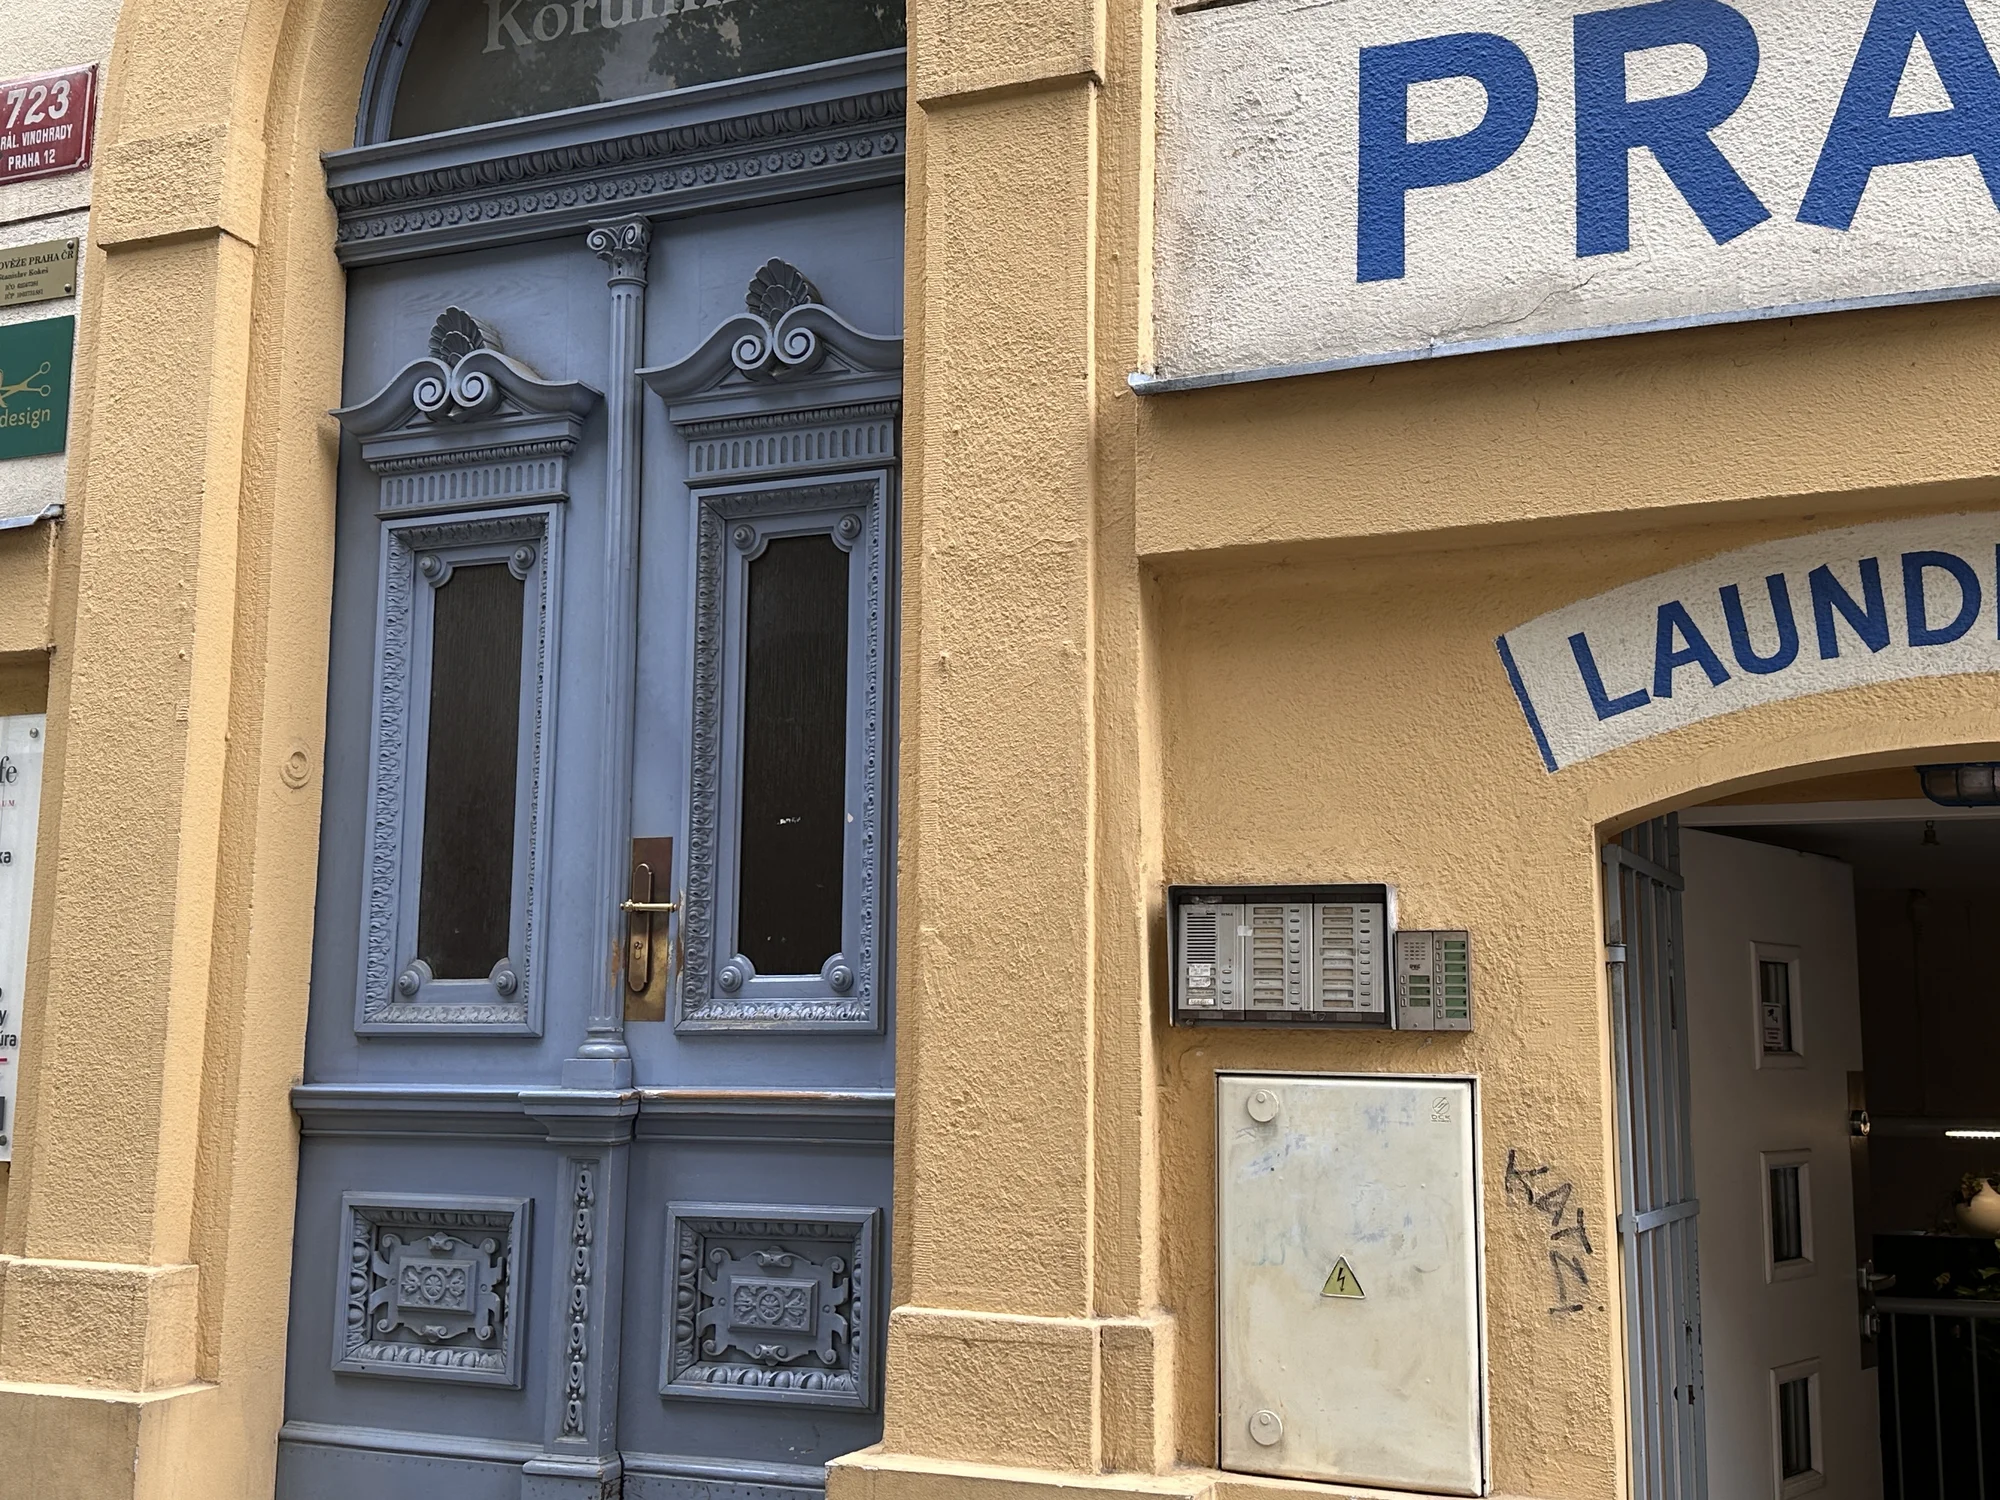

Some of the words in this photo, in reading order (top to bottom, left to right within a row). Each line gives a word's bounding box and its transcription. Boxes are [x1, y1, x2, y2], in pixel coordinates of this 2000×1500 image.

[6, 80, 71, 129] 723
[22, 124, 73, 146] VINOHRADY
[1357, 0, 2000, 283] PRA
[8, 152, 40, 171] PRAHA
[44, 149, 56, 164] 12
[28, 253, 60, 266] PRAHA
[61, 250, 74, 260] ČR
[0, 407, 51, 429] design
[1568, 543, 2000, 722] LAUND
